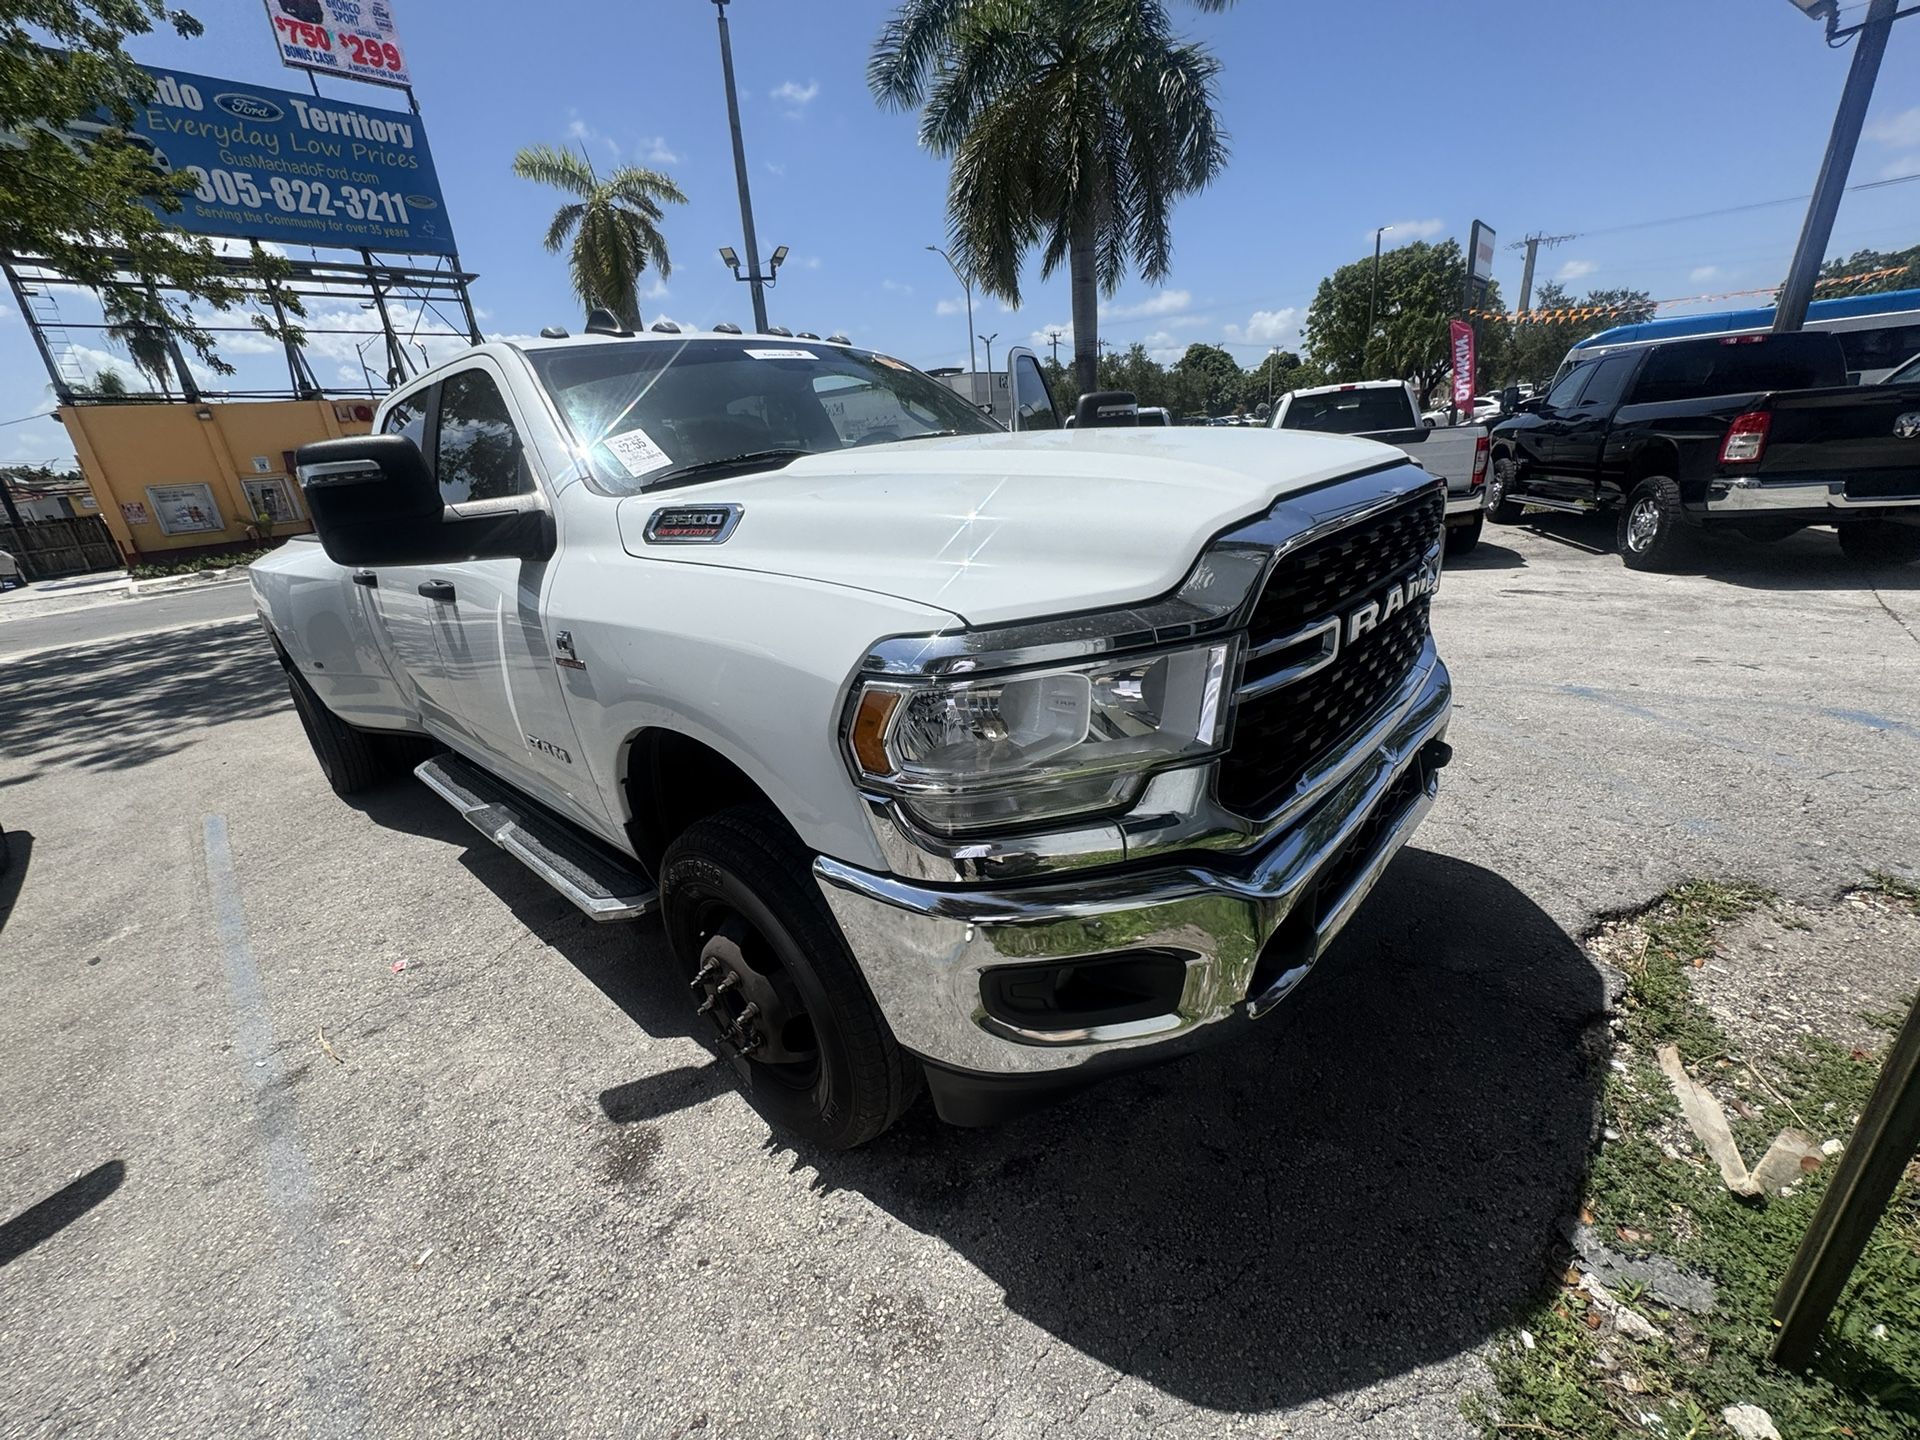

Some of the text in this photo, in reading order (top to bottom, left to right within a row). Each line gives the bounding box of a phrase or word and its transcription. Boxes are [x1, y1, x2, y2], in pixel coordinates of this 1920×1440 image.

[325, 0, 360, 15] BRONCO
[332, 10, 359, 27] SPORT
[275, 15, 331, 52] $750
[283, 44, 313, 61] BONUS
[338, 32, 401, 72] $299
[146, 109, 419, 169] Everyday Low Prices
[230, 98, 270, 117] Ford
[289, 99, 414, 149] Territory
[219, 149, 380, 185] GusMachadoFord.com
[186, 165, 410, 224] 305-822-3211
[195, 205, 243, 224] Serving
[244, 211, 263, 223] the
[264, 213, 326, 232] Community
[328, 219, 344, 232] for
[345, 222, 368, 234] over
[369, 223, 382, 235] 35
[383, 226, 410, 239] years
[663, 513, 724, 526] 3500
[1346, 562, 1430, 646] RAM
